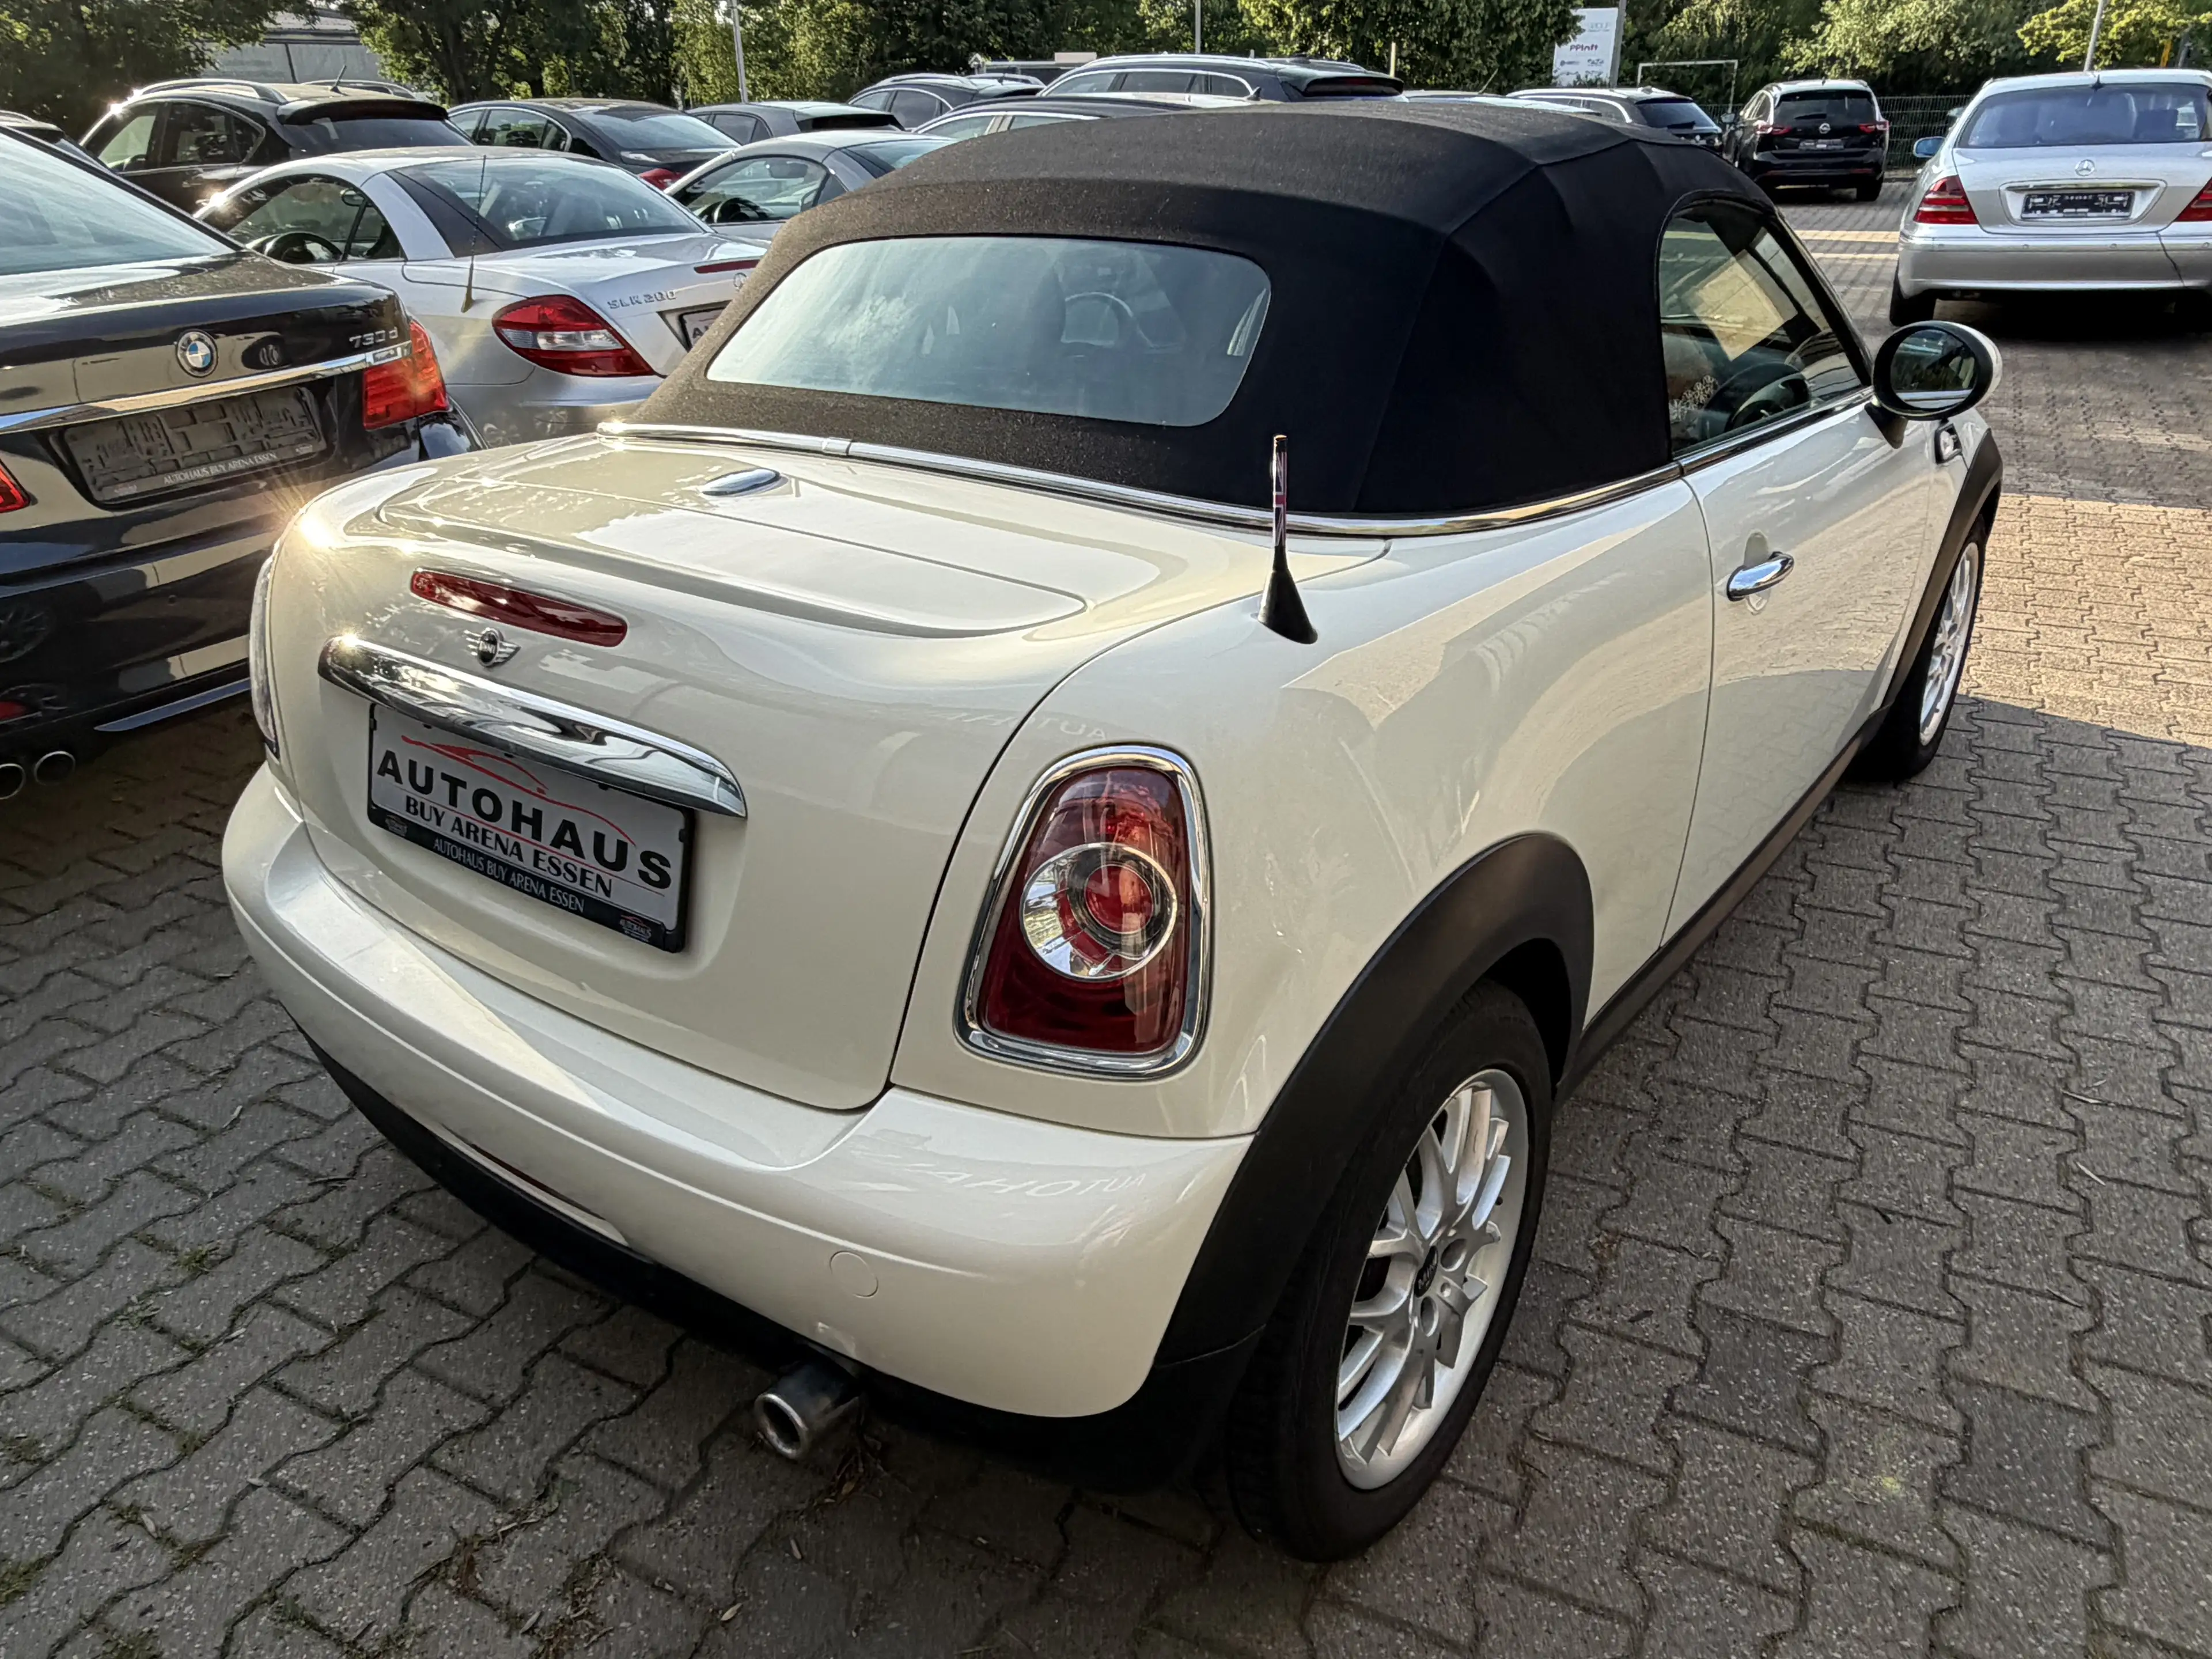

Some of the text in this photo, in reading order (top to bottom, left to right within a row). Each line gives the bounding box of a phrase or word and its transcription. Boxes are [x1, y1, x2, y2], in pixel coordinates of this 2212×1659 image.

[607, 290, 676, 309] SLK 200
[164, 451, 278, 485] AUTOHAUS BUY ARENA ESSEN
[377, 749, 672, 889] AUTOHAUS
[405, 795, 445, 828] BUY
[450, 816, 524, 863] ARENA
[533, 849, 612, 904] ESSEN
[433, 838, 585, 914] AUTOHAUS BUY ARENA ESSEN
